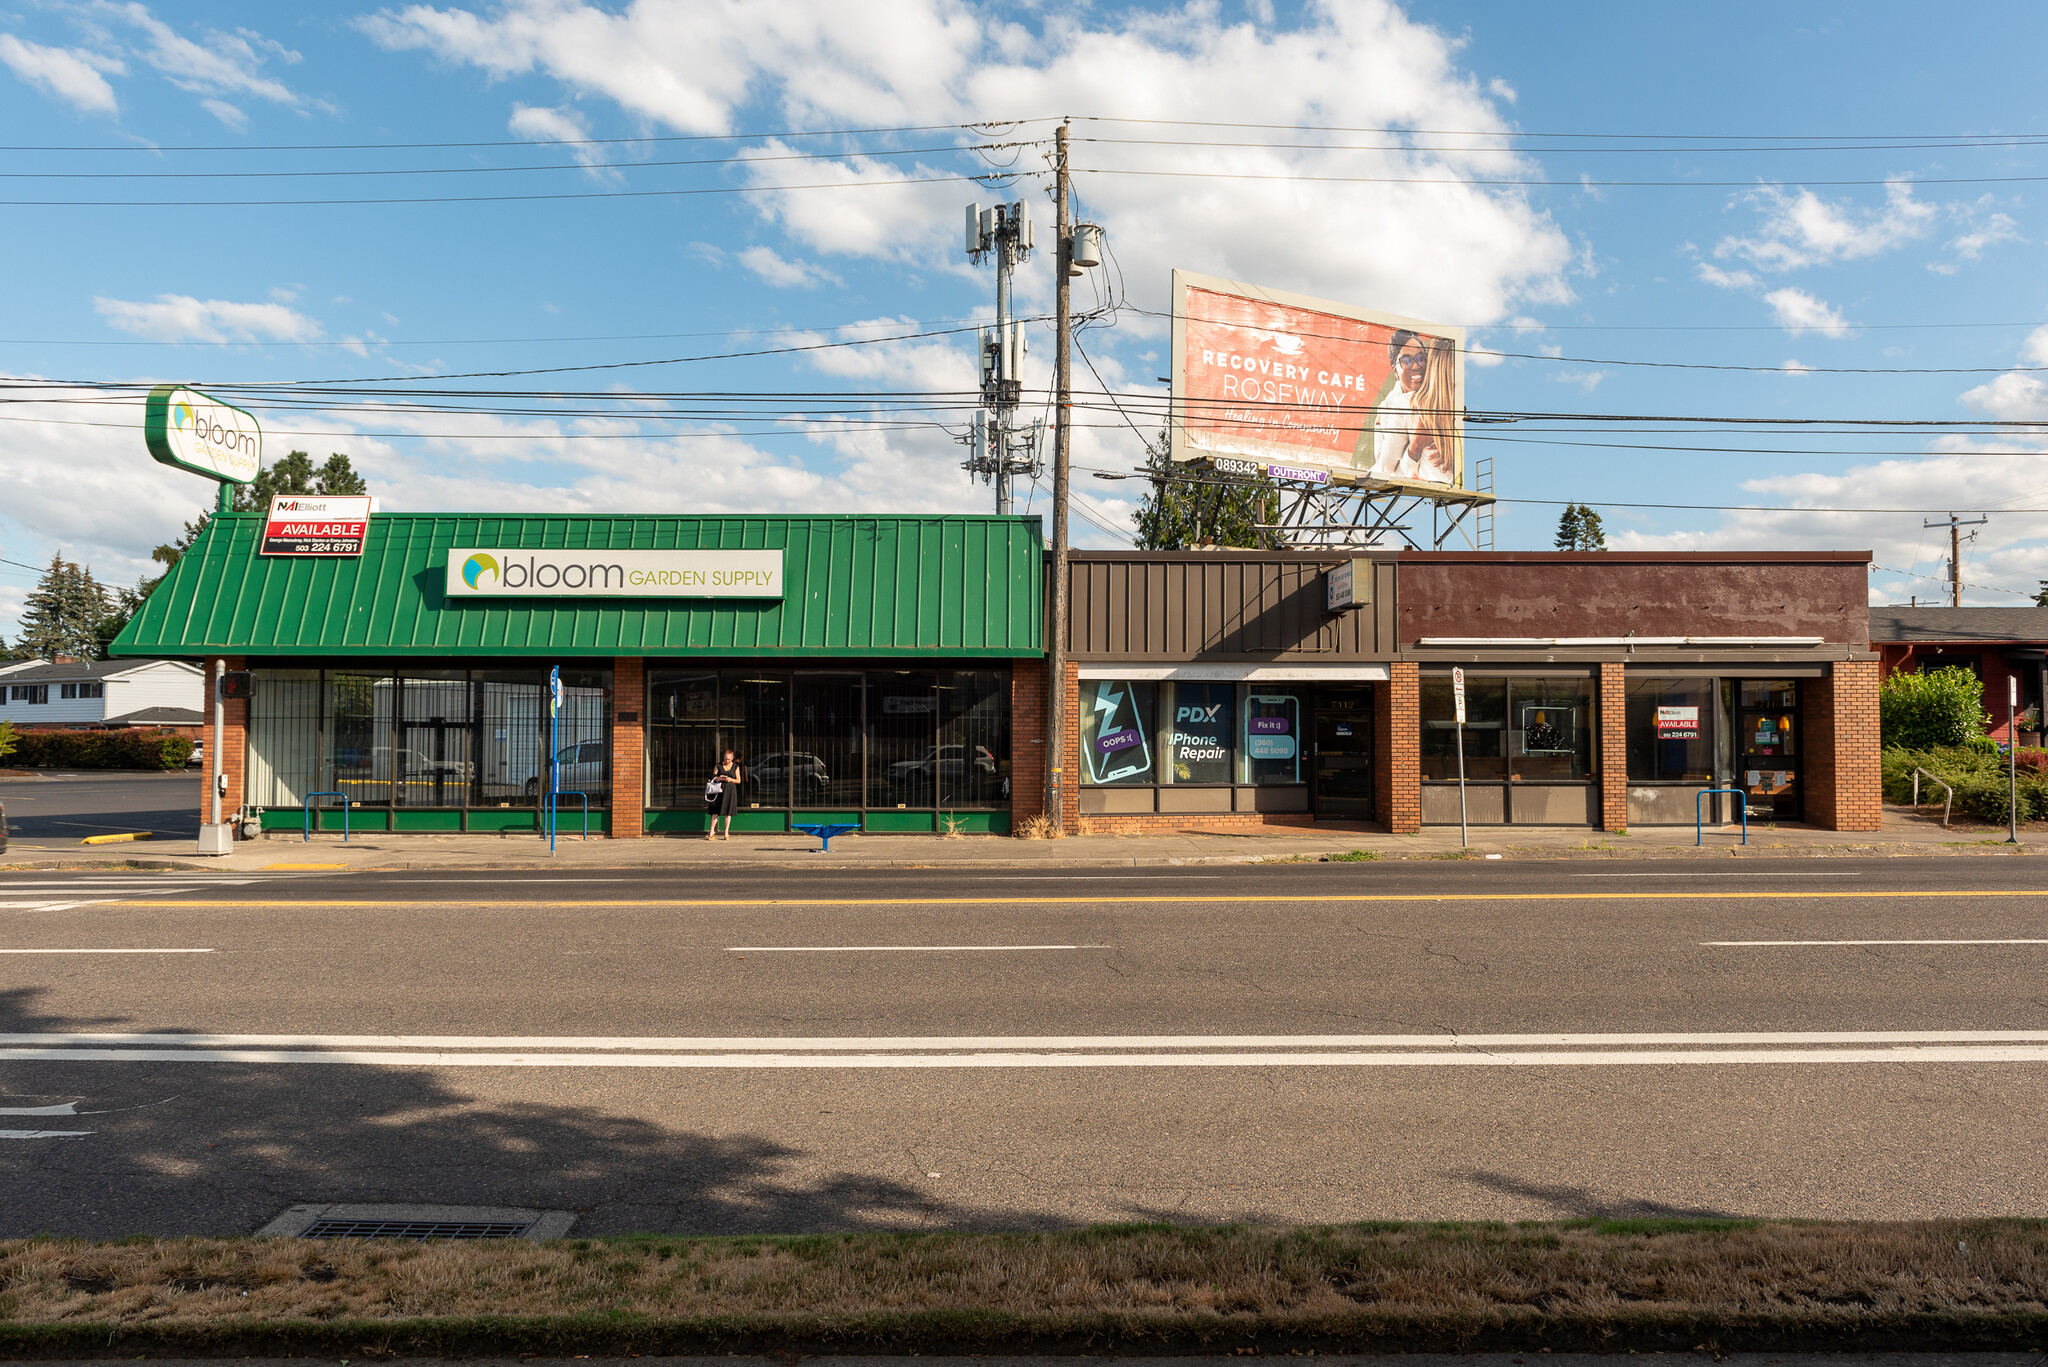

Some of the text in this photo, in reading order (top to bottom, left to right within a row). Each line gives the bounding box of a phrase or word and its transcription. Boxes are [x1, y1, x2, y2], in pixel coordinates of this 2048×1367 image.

[1203, 349, 1366, 392] RECOVERY CAFÉ
[1224, 374, 1346, 414] ROSEWAY
[1224, 405, 1340, 443] Healing in Community
[195, 409, 256, 458] bloom
[194, 441, 256, 472] GARDEN SUPPLY
[1216, 458, 1258, 475] 089342
[1273, 466, 1322, 482] OUTFRONT
[281, 524, 361, 536] AVAILABLE
[311, 543, 330, 552] 224
[333, 543, 358, 552] 6791
[503, 556, 773, 588] bloom GARDEN SUPPLY
[1176, 704, 1221, 722] PDX
[1103, 735, 1126, 748] OOPS
[1180, 747, 1226, 761] Repair
